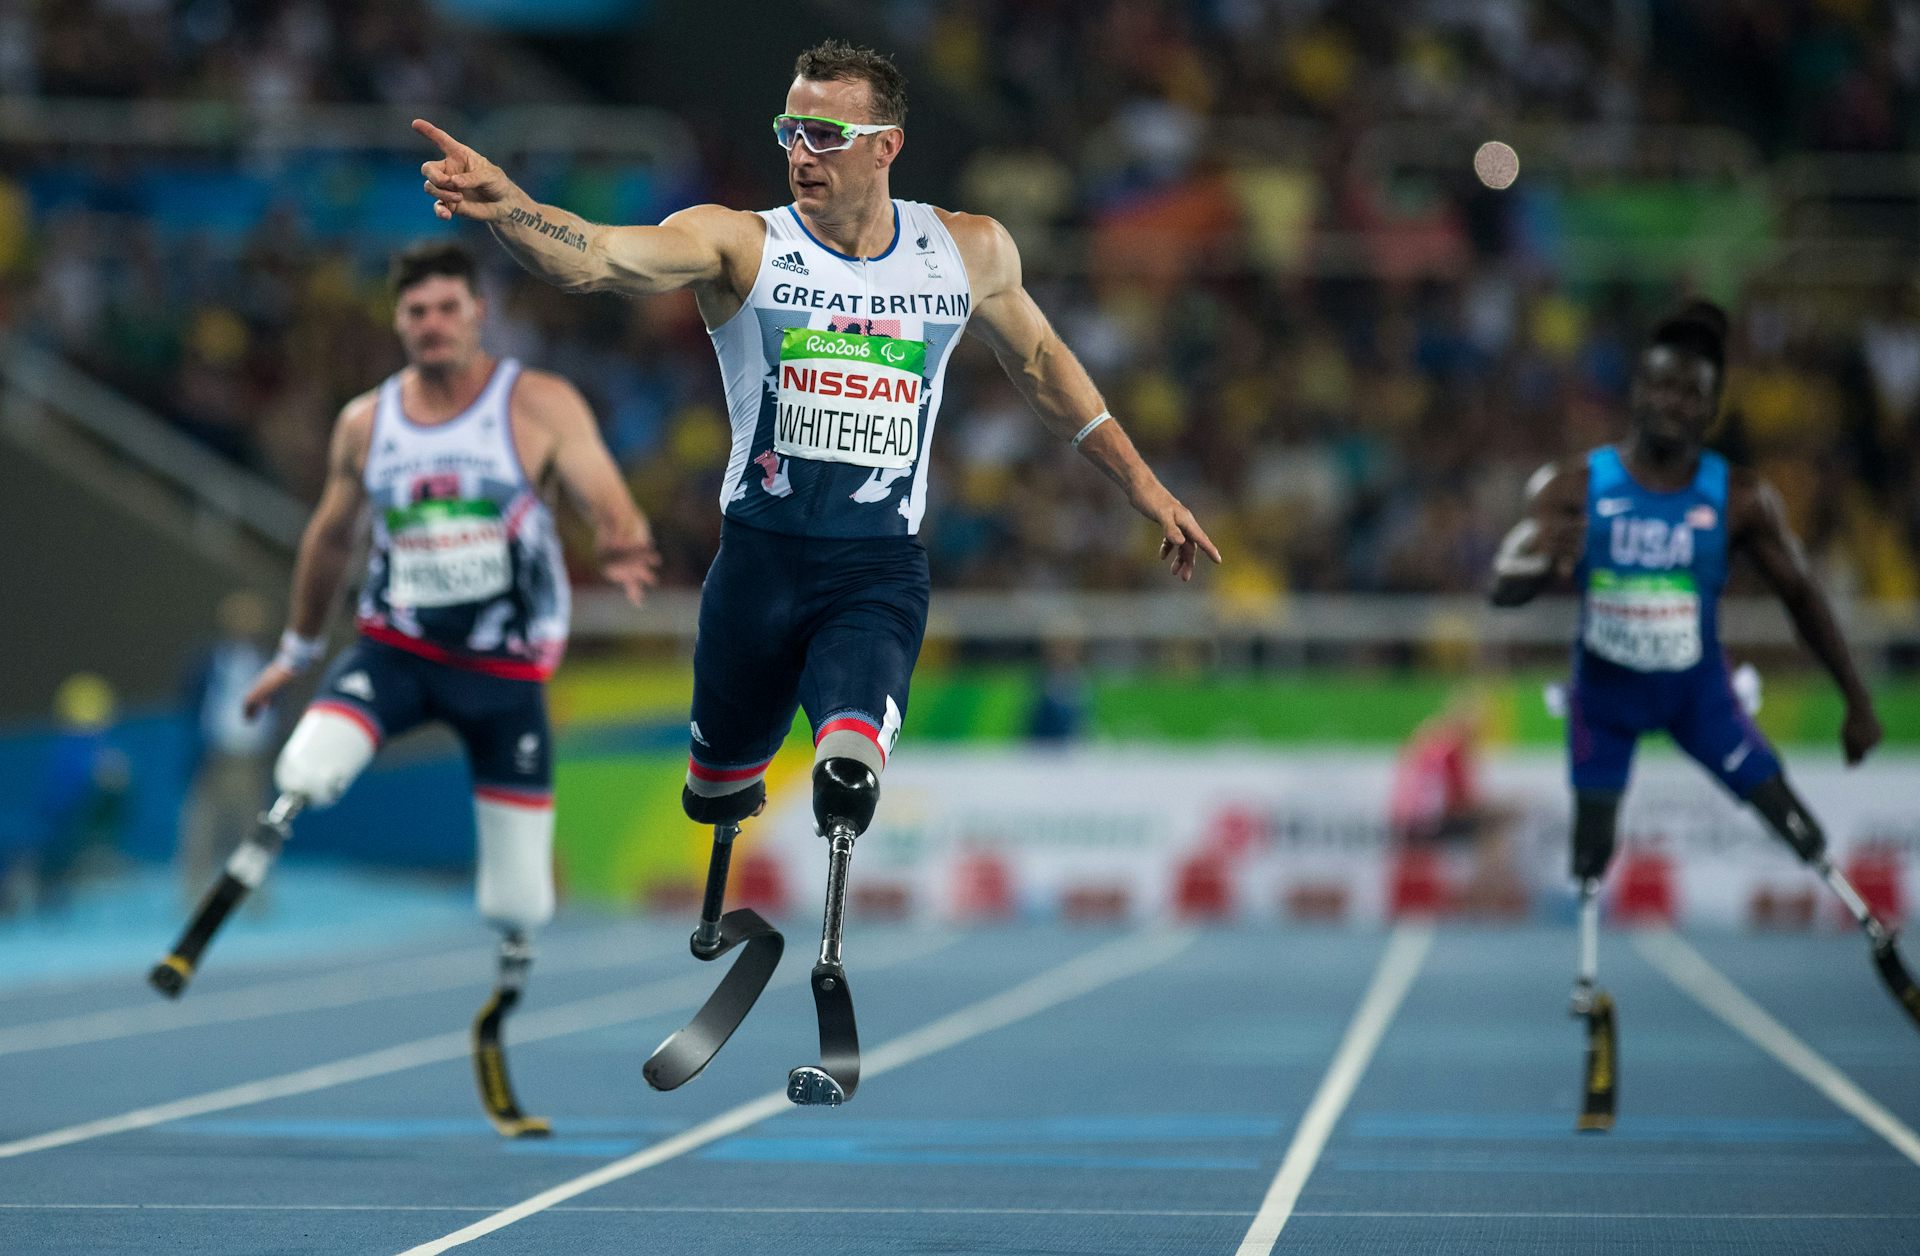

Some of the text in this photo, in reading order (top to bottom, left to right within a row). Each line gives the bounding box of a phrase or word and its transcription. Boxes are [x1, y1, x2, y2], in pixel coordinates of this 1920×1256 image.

[772, 260, 810, 276] adidas
[773, 283, 969, 318] GREAT BRITAIN
[806, 335, 871, 358] Rio2016
[783, 366, 917, 404] NISSAN
[778, 403, 913, 457] WHITEHEAD
[1611, 516, 1694, 568] USA
